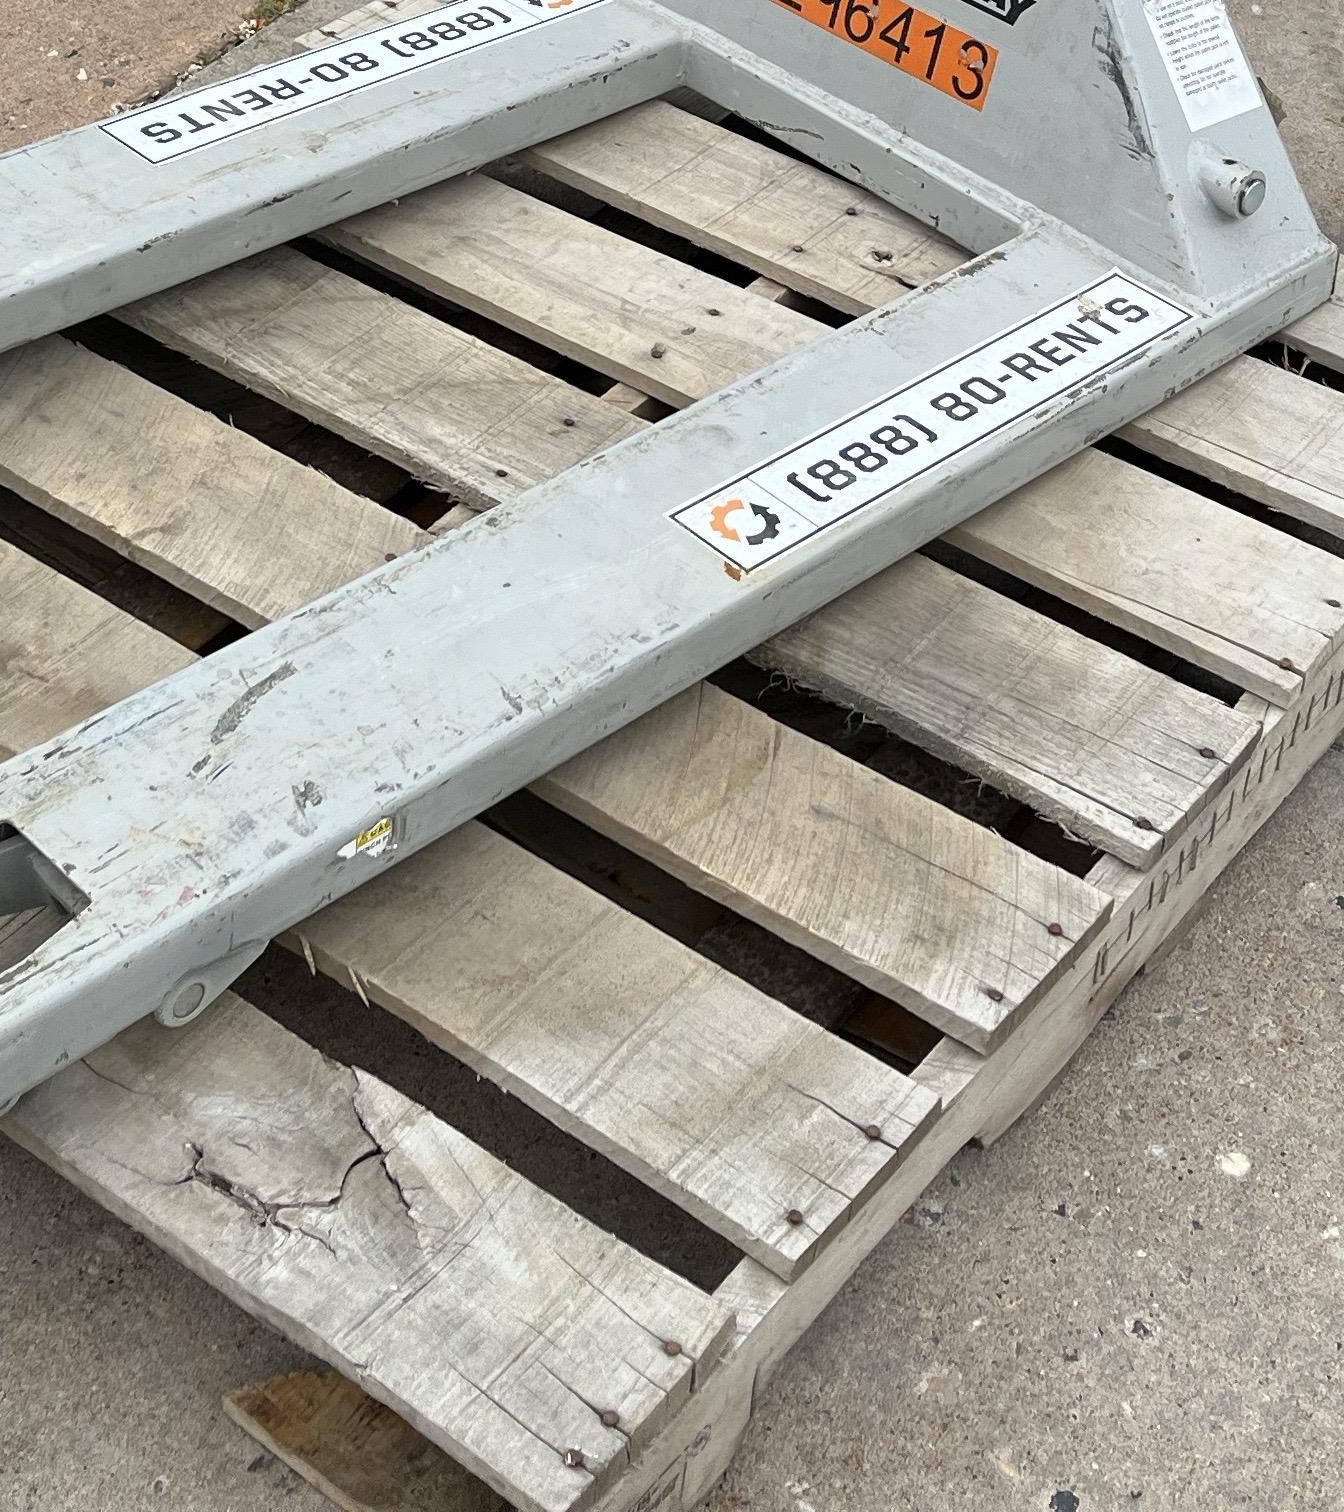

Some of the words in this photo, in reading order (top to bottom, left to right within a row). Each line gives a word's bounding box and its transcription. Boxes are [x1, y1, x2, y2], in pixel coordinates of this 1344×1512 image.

[381, 6, 513, 58] (888)
[140, 52, 380, 144] 80-RENTS
[787, 414, 938, 502] (888)
[929, 297, 1149, 422] 80-RENTS
